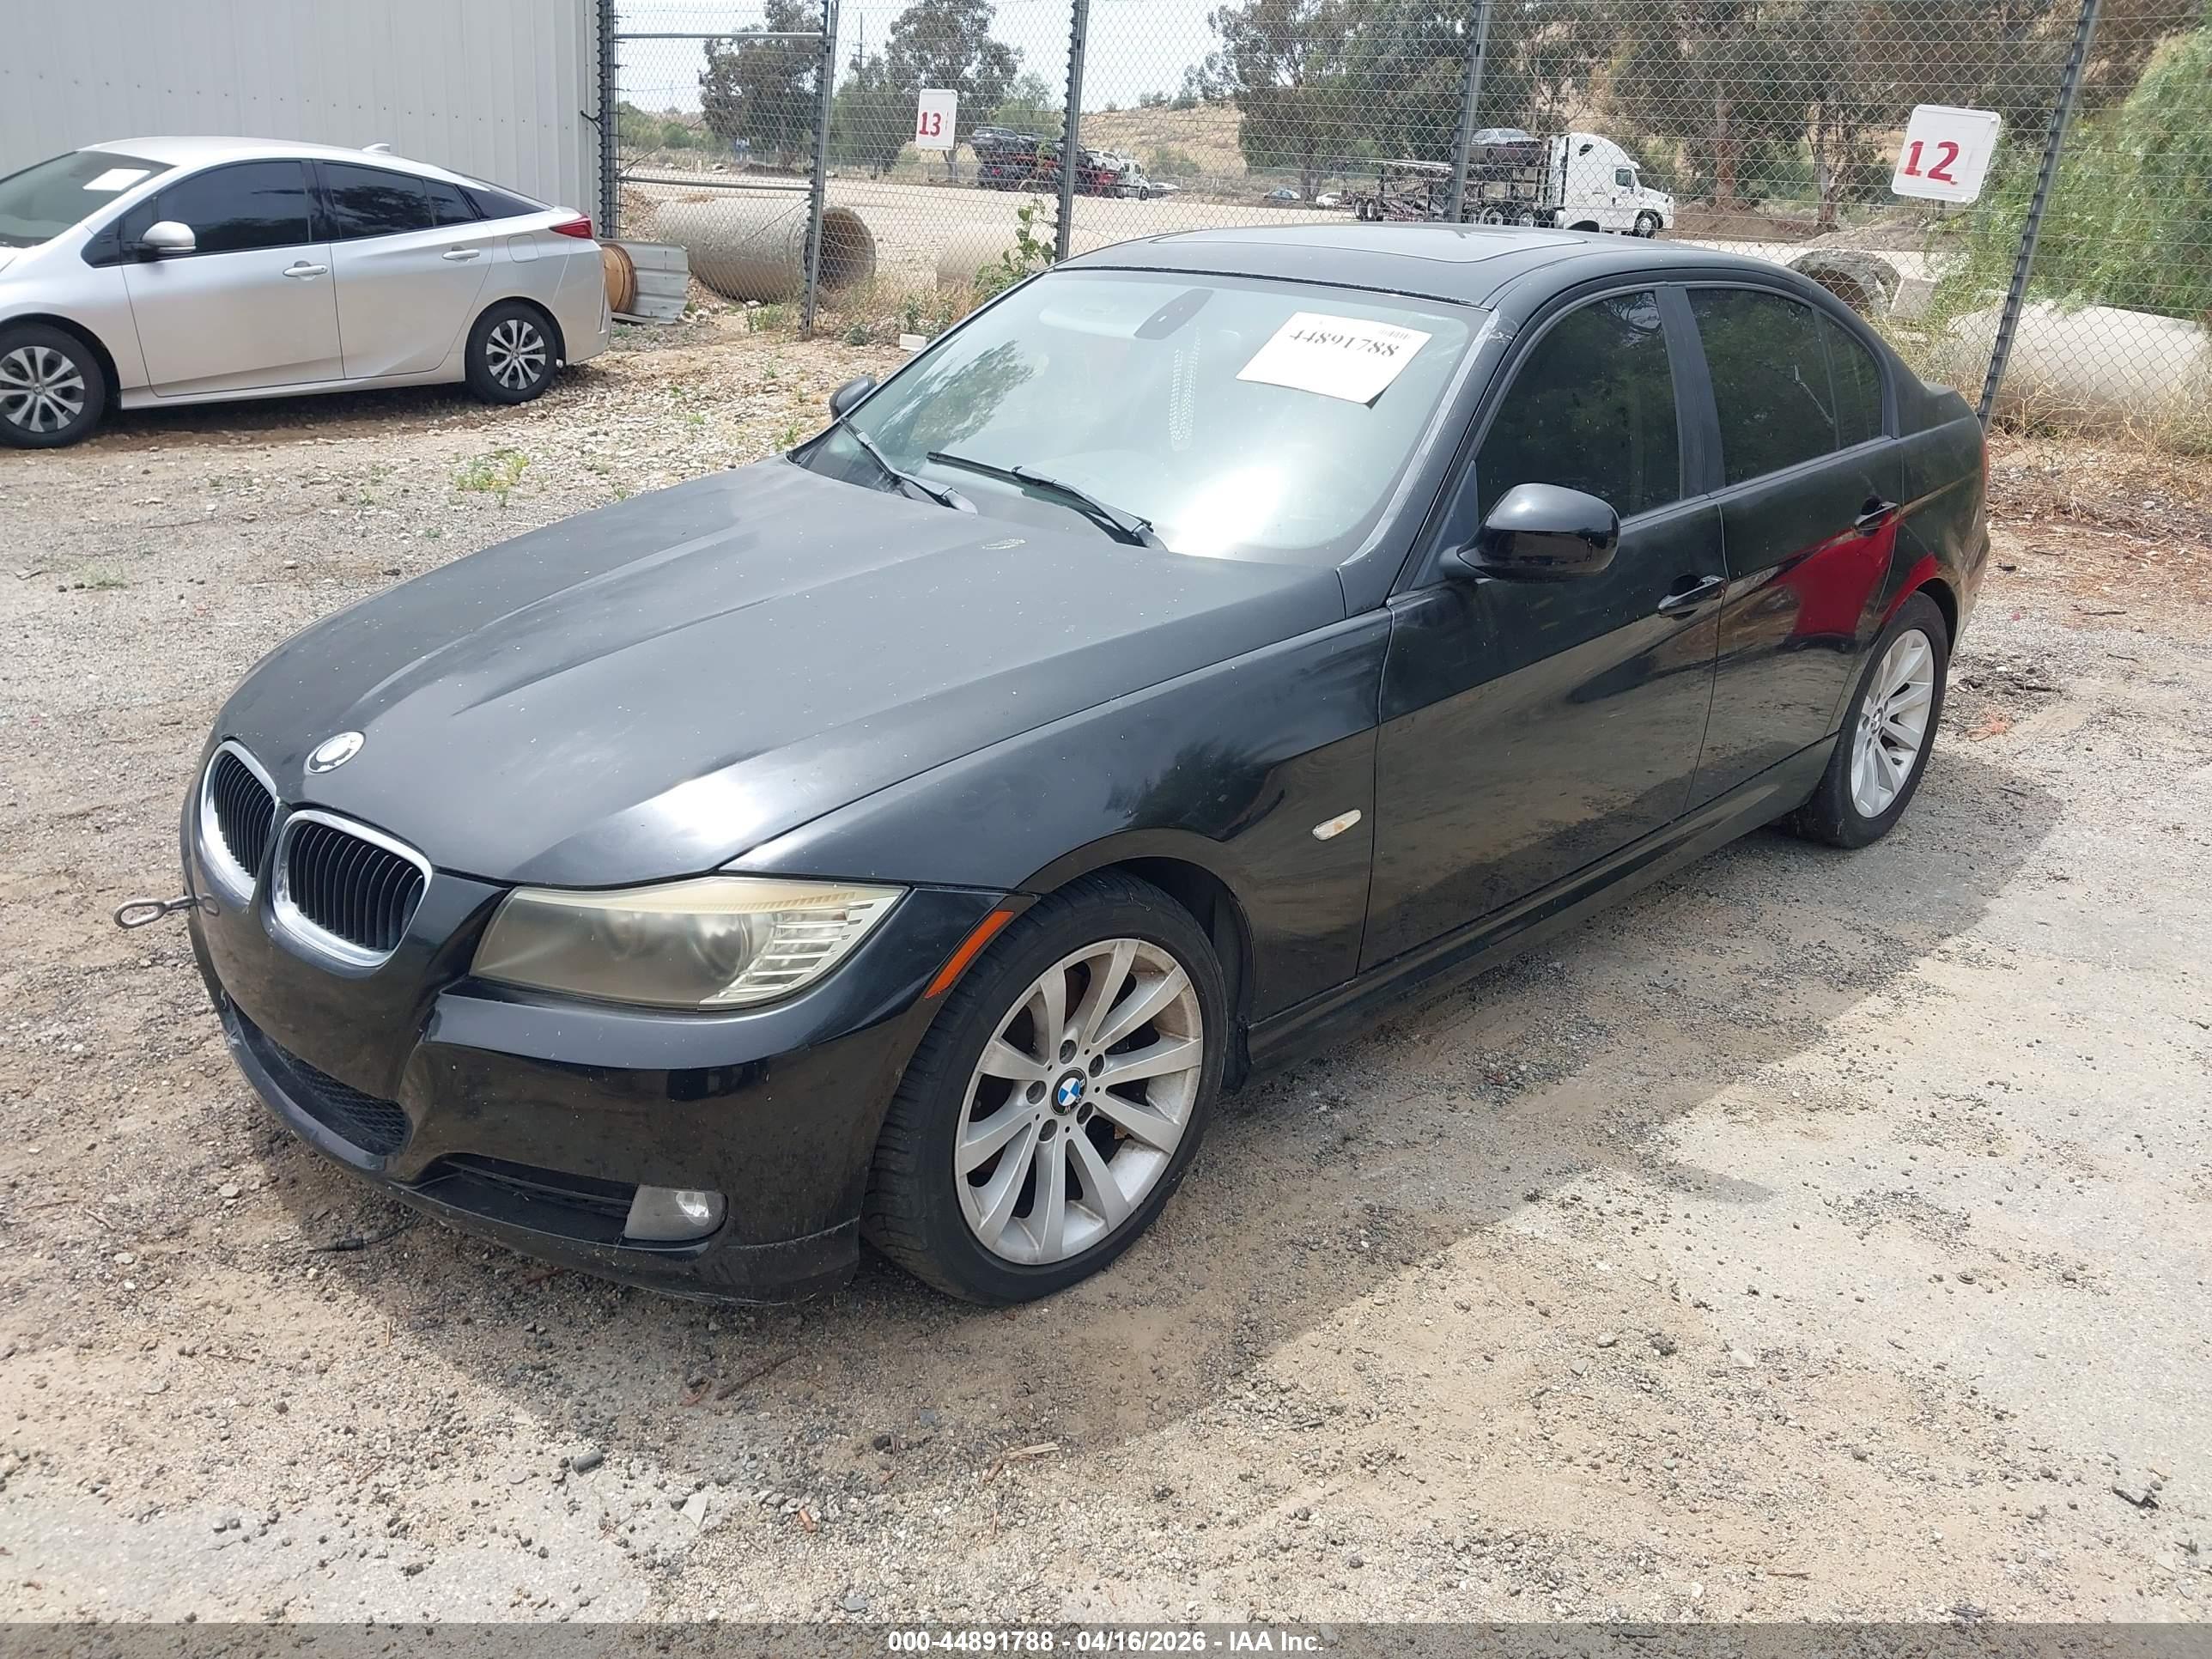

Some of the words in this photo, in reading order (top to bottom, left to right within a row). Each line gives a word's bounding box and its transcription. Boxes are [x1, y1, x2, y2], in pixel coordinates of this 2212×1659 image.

[919, 112, 942, 137] 13
[1904, 140, 1960, 182] 12
[1289, 329, 1400, 357] 44891788
